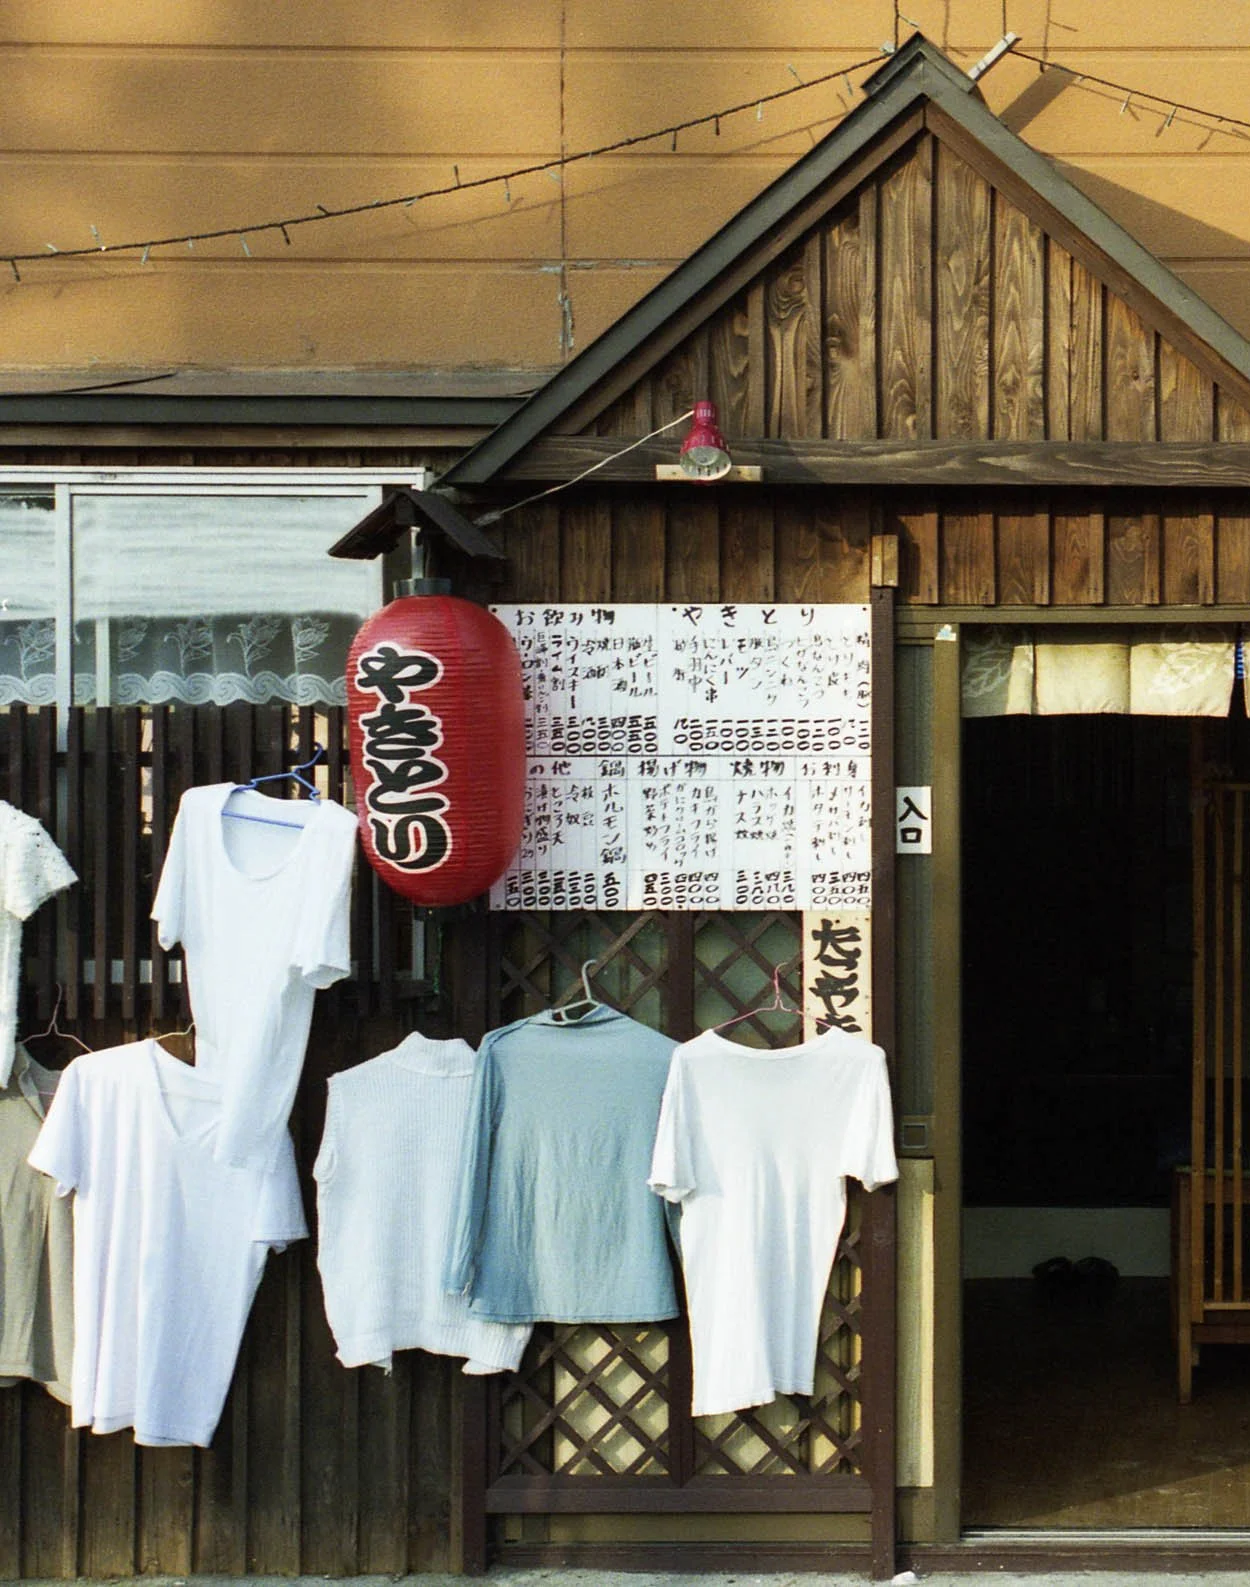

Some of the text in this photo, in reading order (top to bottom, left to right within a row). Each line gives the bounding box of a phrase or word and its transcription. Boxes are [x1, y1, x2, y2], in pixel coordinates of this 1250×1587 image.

[516, 608, 615, 626] お飲み物
[682, 606, 815, 626] やきとり
[355, 642, 451, 873] やきとり
[529, 760, 571, 775] の他
[598, 759, 626, 777] 鍋
[638, 759, 707, 777] 揚げ物
[600, 783, 627, 864] ホルモン鍋
[898, 796, 928, 844] 入口
